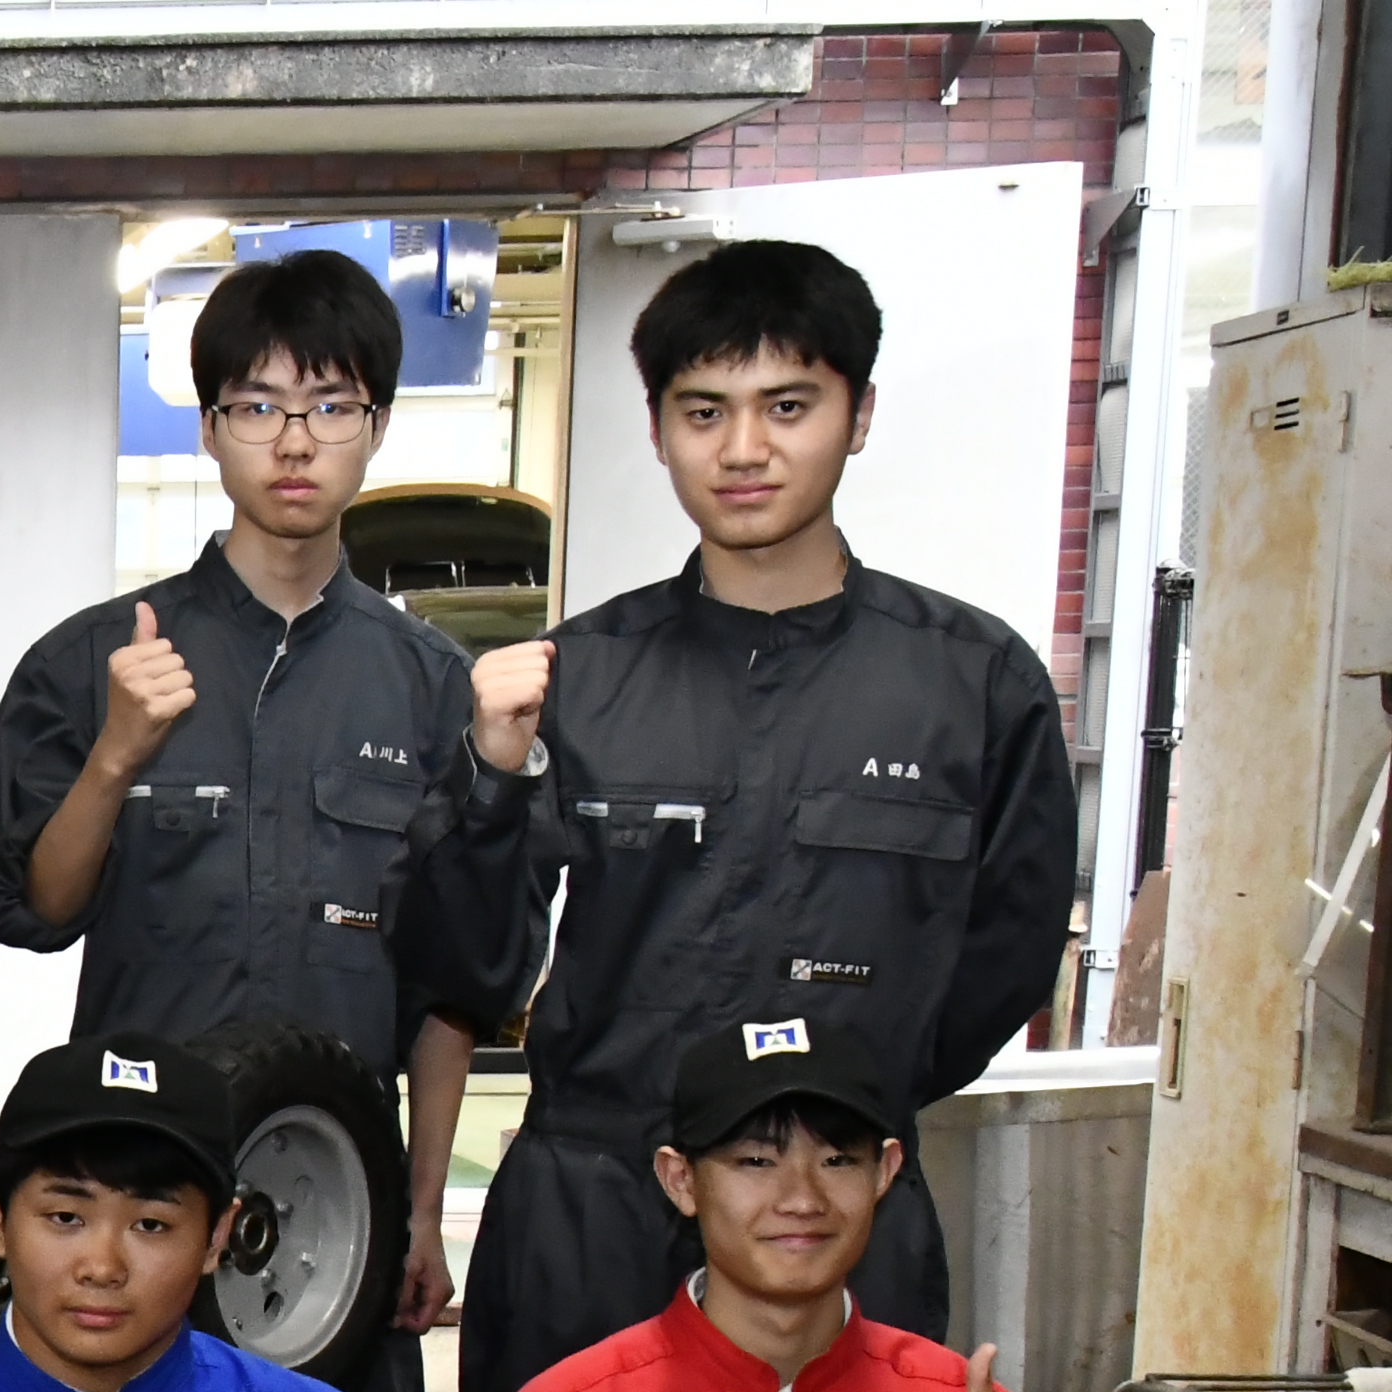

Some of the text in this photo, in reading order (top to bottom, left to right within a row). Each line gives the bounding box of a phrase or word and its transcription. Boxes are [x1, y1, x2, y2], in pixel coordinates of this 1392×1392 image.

[359, 741, 372, 758] A
[862, 757, 878, 777] A
[813, 962, 871, 976] ACT-FIT
